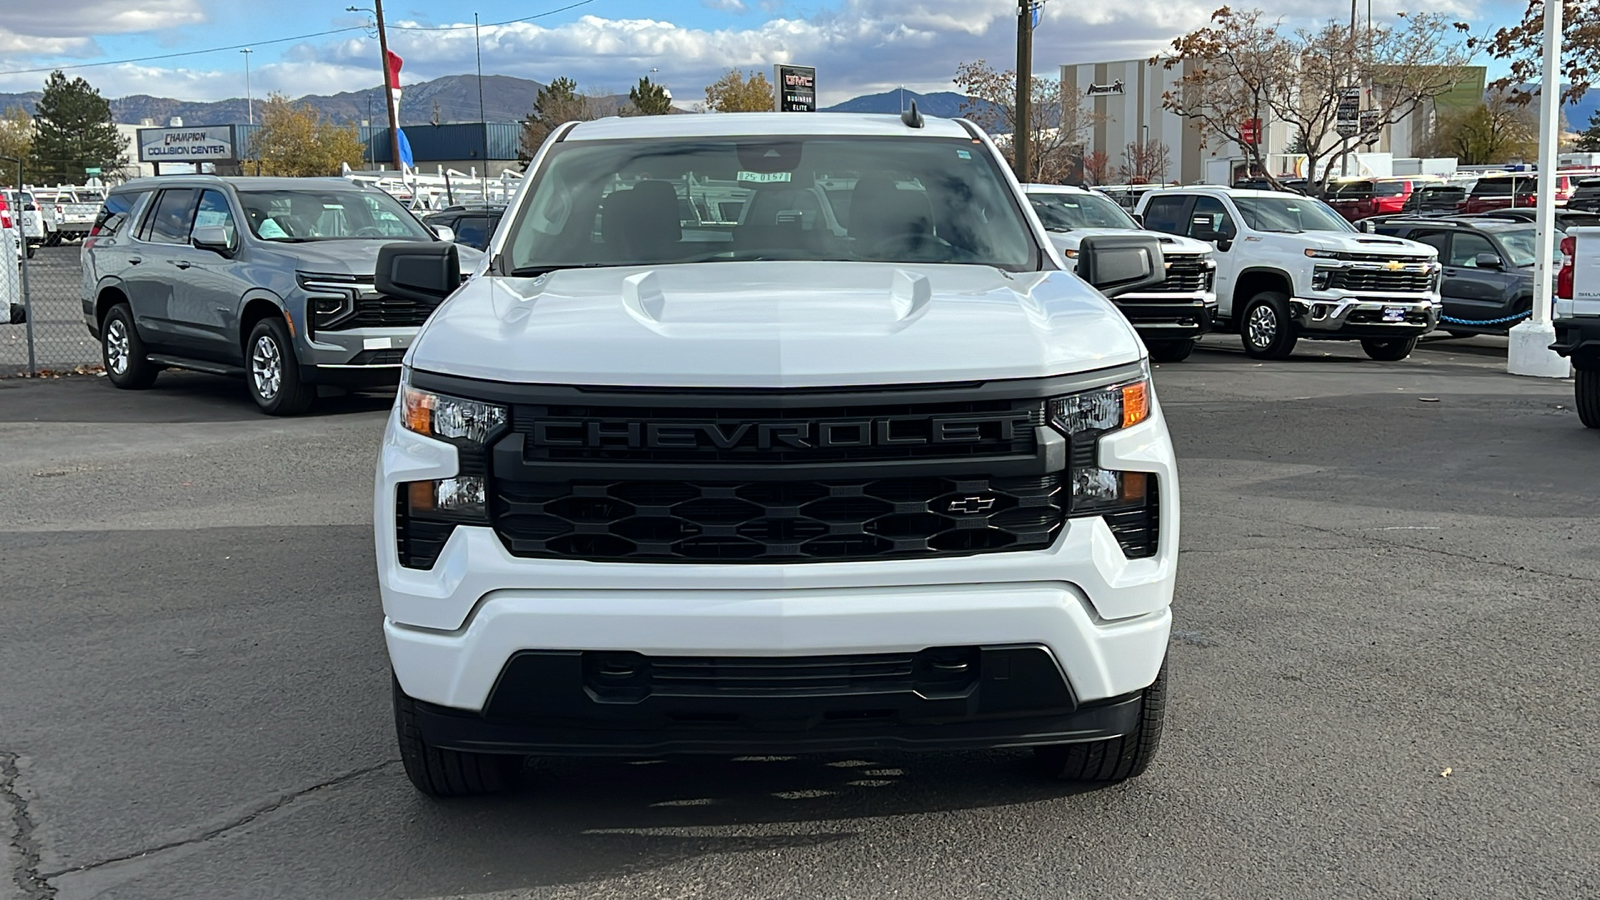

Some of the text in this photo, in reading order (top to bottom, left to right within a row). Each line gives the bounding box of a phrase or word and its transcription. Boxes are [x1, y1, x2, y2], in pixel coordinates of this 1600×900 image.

[786, 74, 812, 87] GMC
[792, 104, 808, 112] ELITE
[165, 132, 206, 145] CHAMPION
[148, 146, 225, 155] COLLISION CENTER
[533, 410, 1031, 449] CHEVROLET
